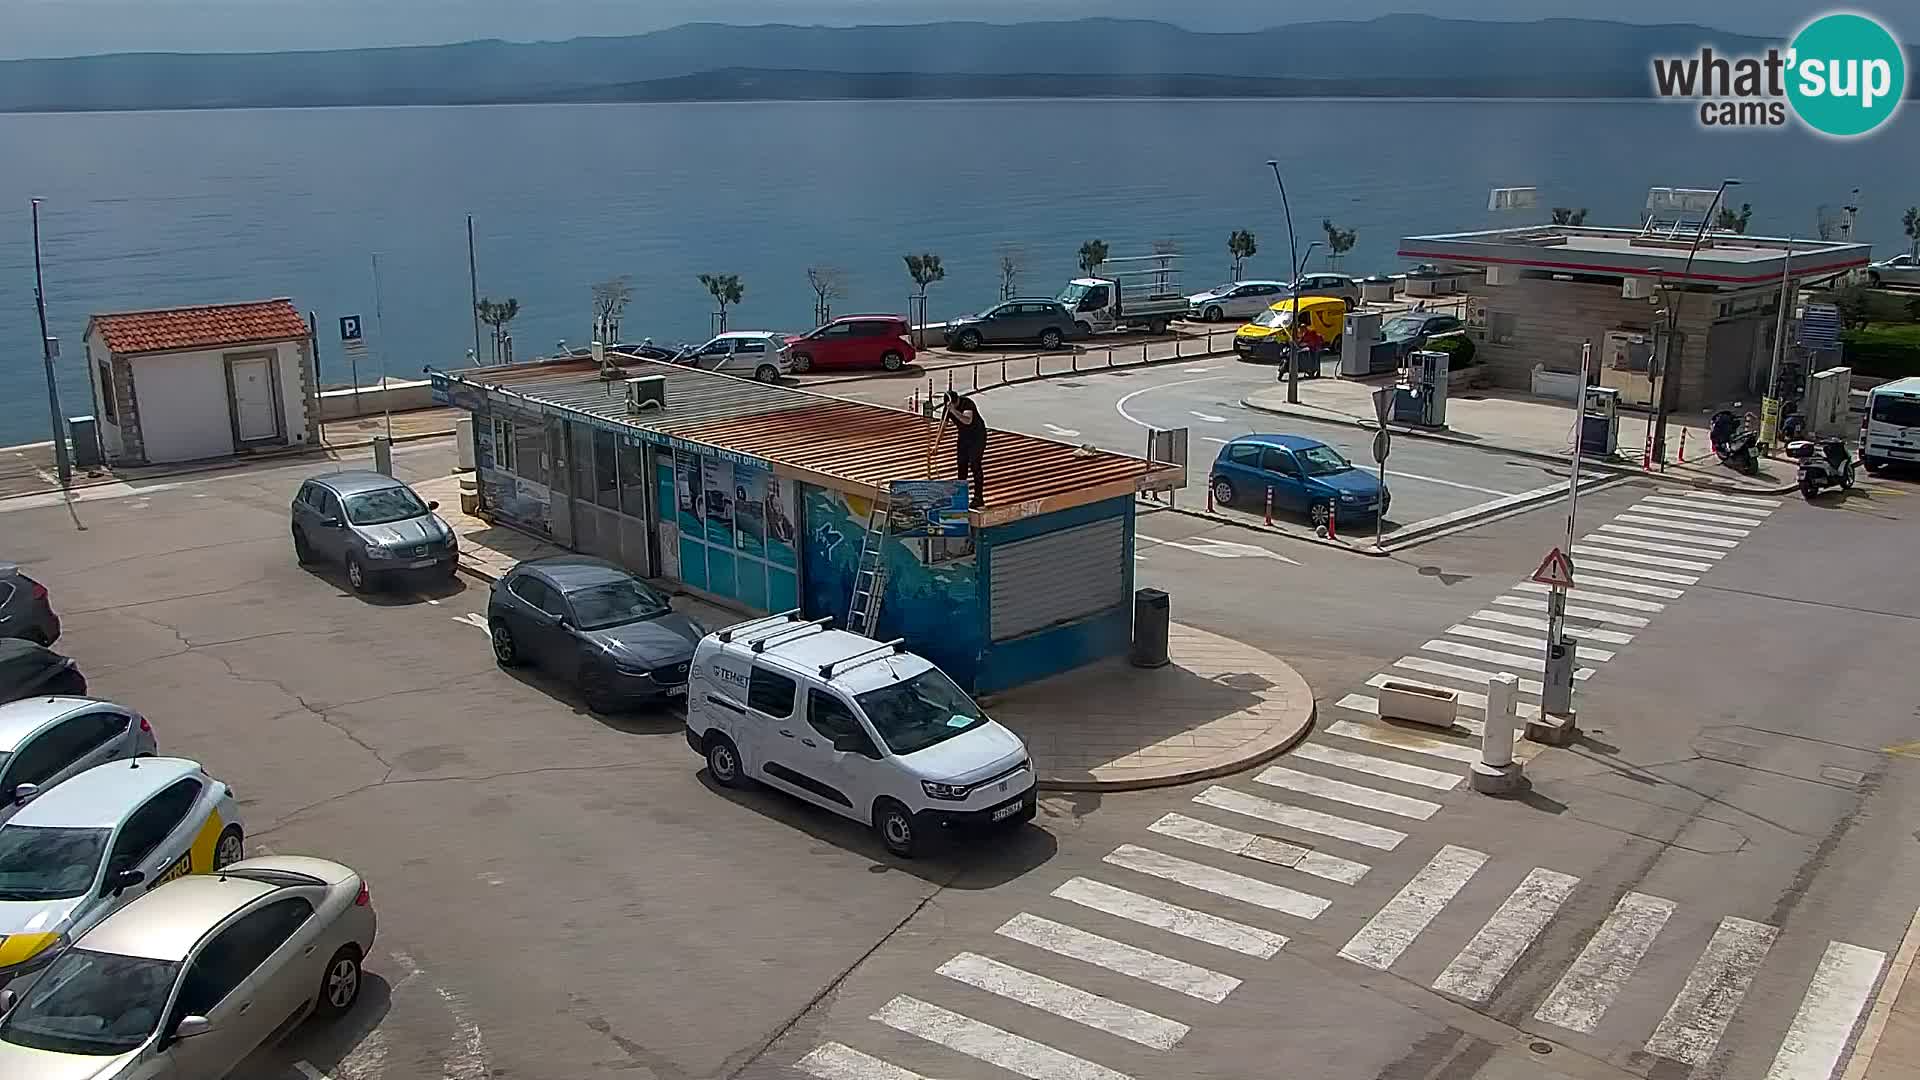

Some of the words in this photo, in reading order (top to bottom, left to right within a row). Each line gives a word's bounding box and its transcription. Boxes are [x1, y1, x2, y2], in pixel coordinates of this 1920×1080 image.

[344, 319, 356, 337] P
[669, 437, 683, 449] BUS
[684, 442, 715, 457] STATION
[717, 449, 741, 463] TICKET
[743, 456, 769, 470] OFFICE
